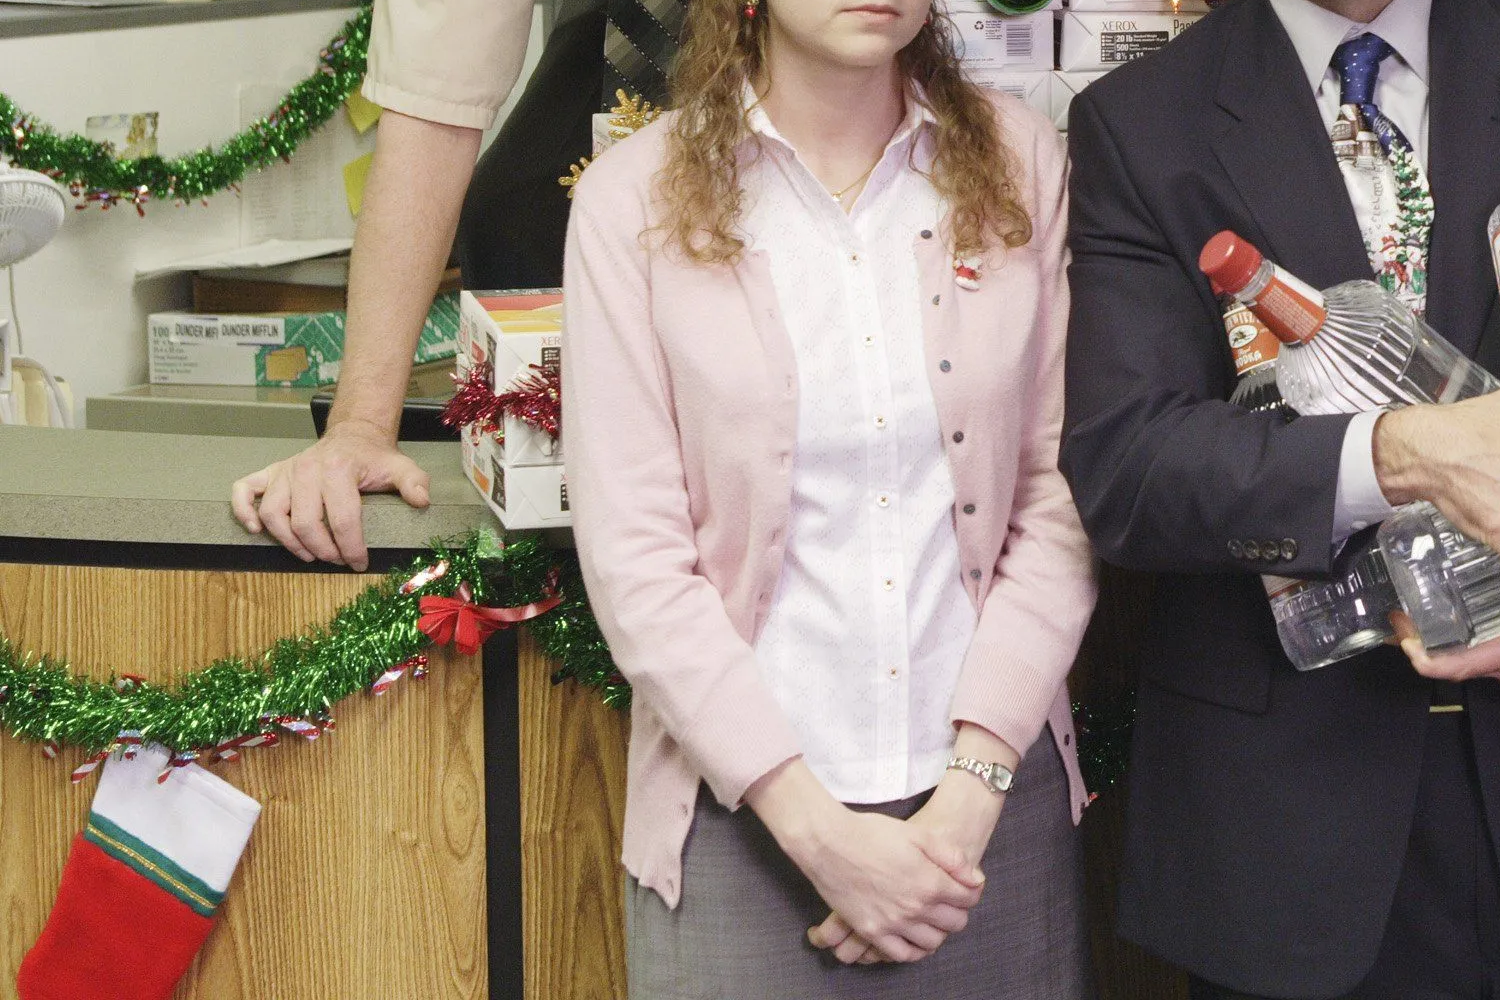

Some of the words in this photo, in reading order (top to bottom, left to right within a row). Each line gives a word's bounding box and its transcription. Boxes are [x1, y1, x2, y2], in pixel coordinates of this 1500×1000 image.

[1102, 21, 1137, 31] XEROX
[153, 326, 169, 338] 100
[175, 323, 202, 338] DUNDER
[222, 324, 249, 337] DUNDER
[252, 324, 278, 337] MIFFLIN
[541, 336, 561, 346] XER
